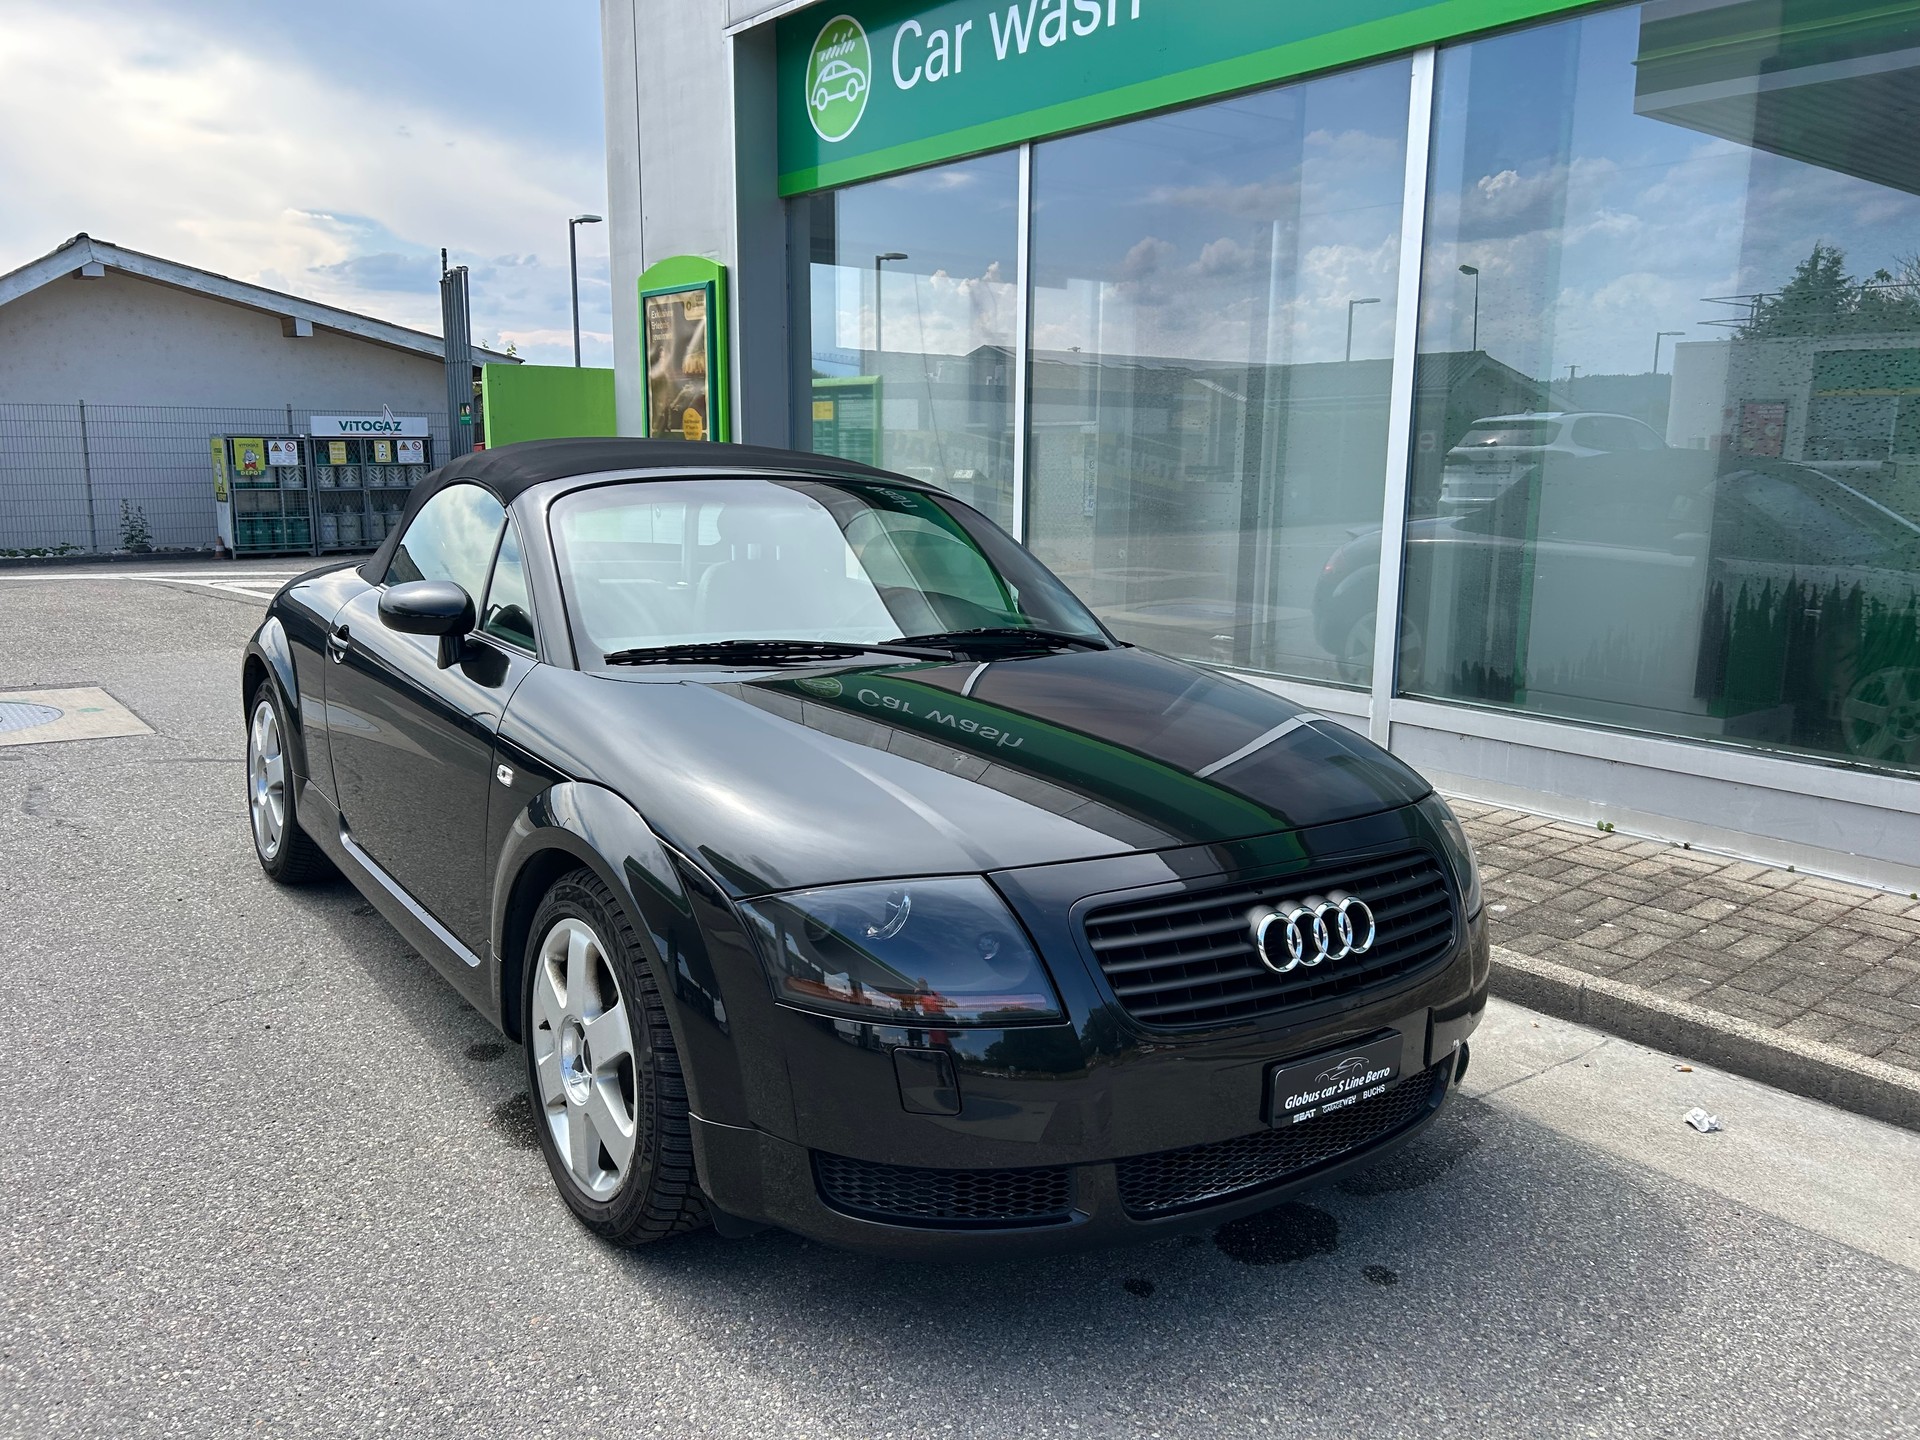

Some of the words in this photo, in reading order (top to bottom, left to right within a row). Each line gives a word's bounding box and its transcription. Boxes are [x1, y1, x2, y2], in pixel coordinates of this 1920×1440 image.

[892, 19, 972, 91] Car
[1284, 1089, 1320, 1110] Globus
[1320, 1085, 1337, 1098] car
[1337, 1080, 1345, 1093] S
[1345, 1075, 1364, 1091] Line
[1365, 1067, 1390, 1083] Berro
[1362, 1084, 1386, 1100] BUCHS
